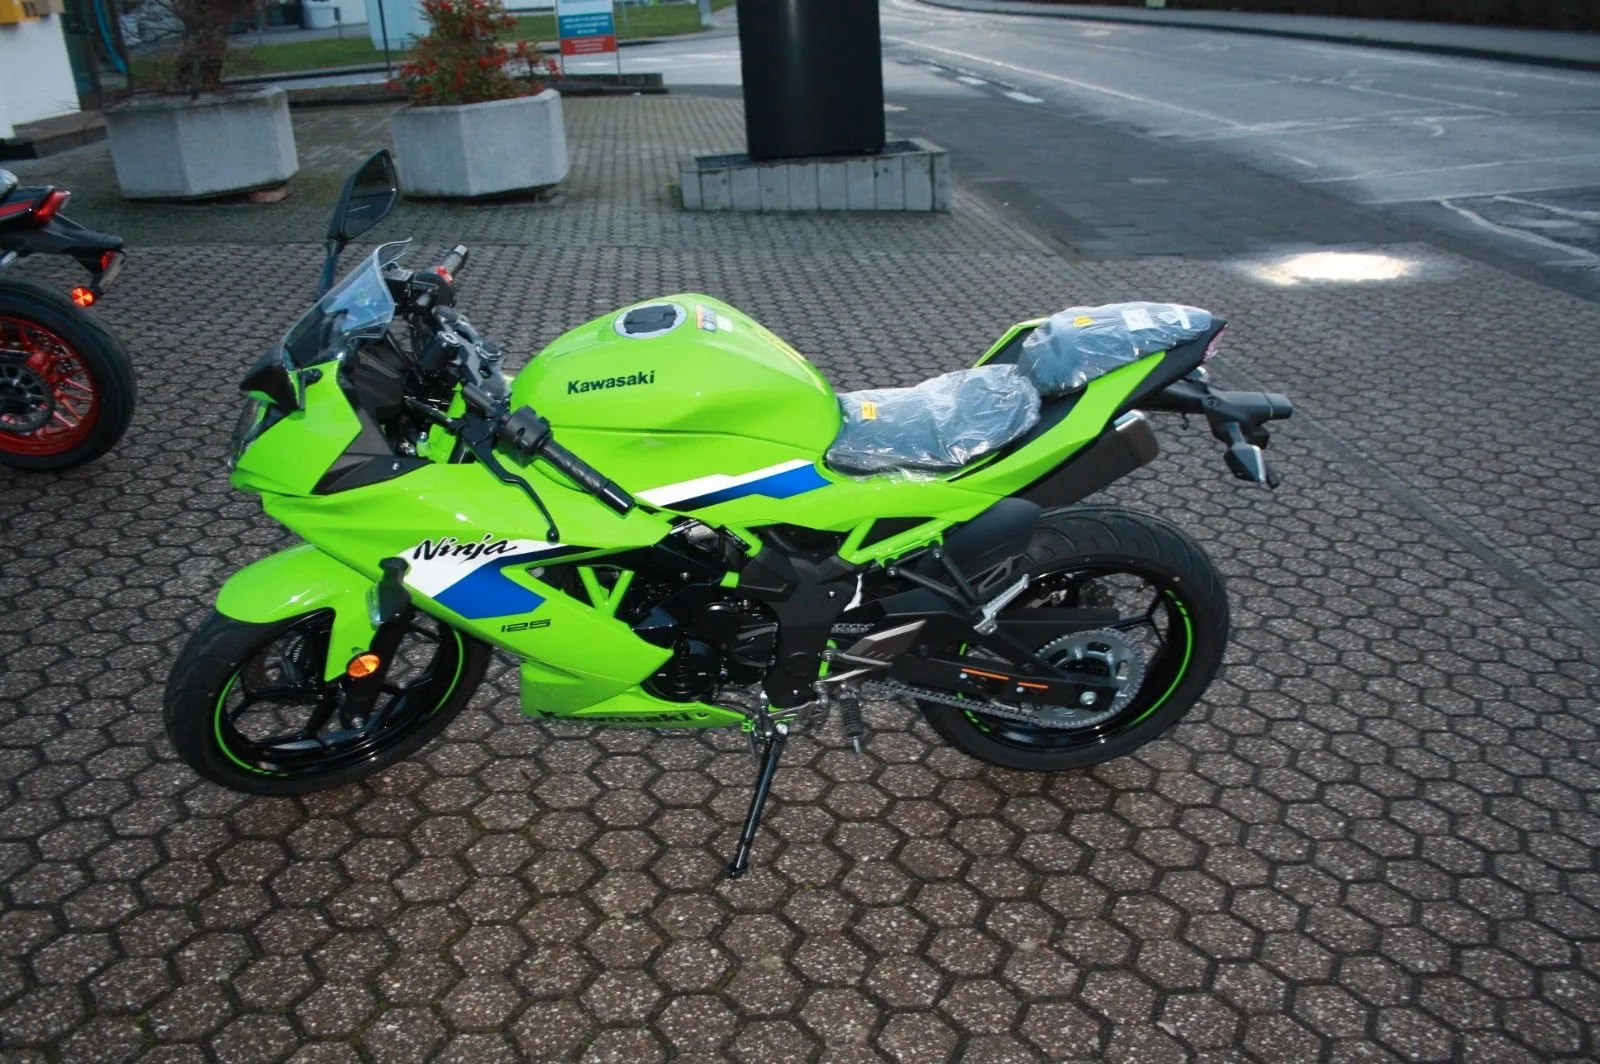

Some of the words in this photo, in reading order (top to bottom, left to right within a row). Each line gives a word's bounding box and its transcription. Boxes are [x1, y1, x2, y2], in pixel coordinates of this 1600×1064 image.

[567, 370, 655, 395] Kawasaki
[413, 534, 518, 563] Ninja
[500, 619, 552, 633] 125
